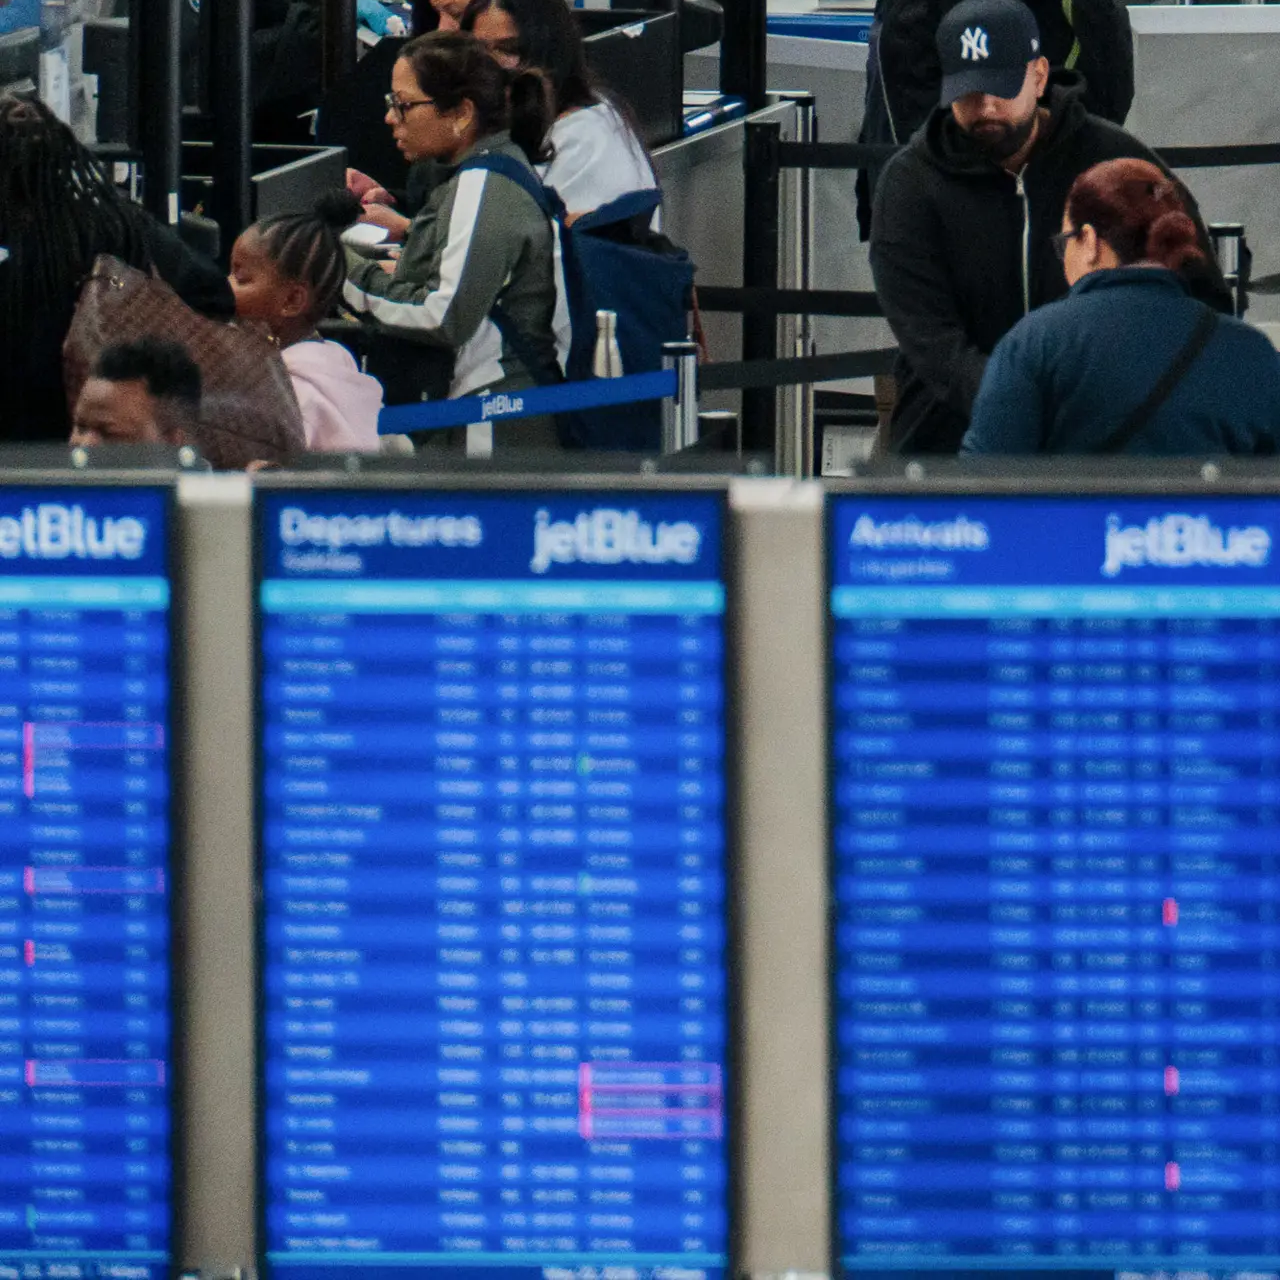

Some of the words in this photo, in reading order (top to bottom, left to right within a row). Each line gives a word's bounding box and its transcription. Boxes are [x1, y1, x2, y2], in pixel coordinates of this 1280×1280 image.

[960, 27, 989, 61] NY
[481, 394, 524, 420] jetBlue
[0, 504, 146, 559] etBlue
[279, 508, 482, 553] Departures
[531, 508, 700, 573] jetBlue
[1101, 512, 1271, 577] jetBlue
